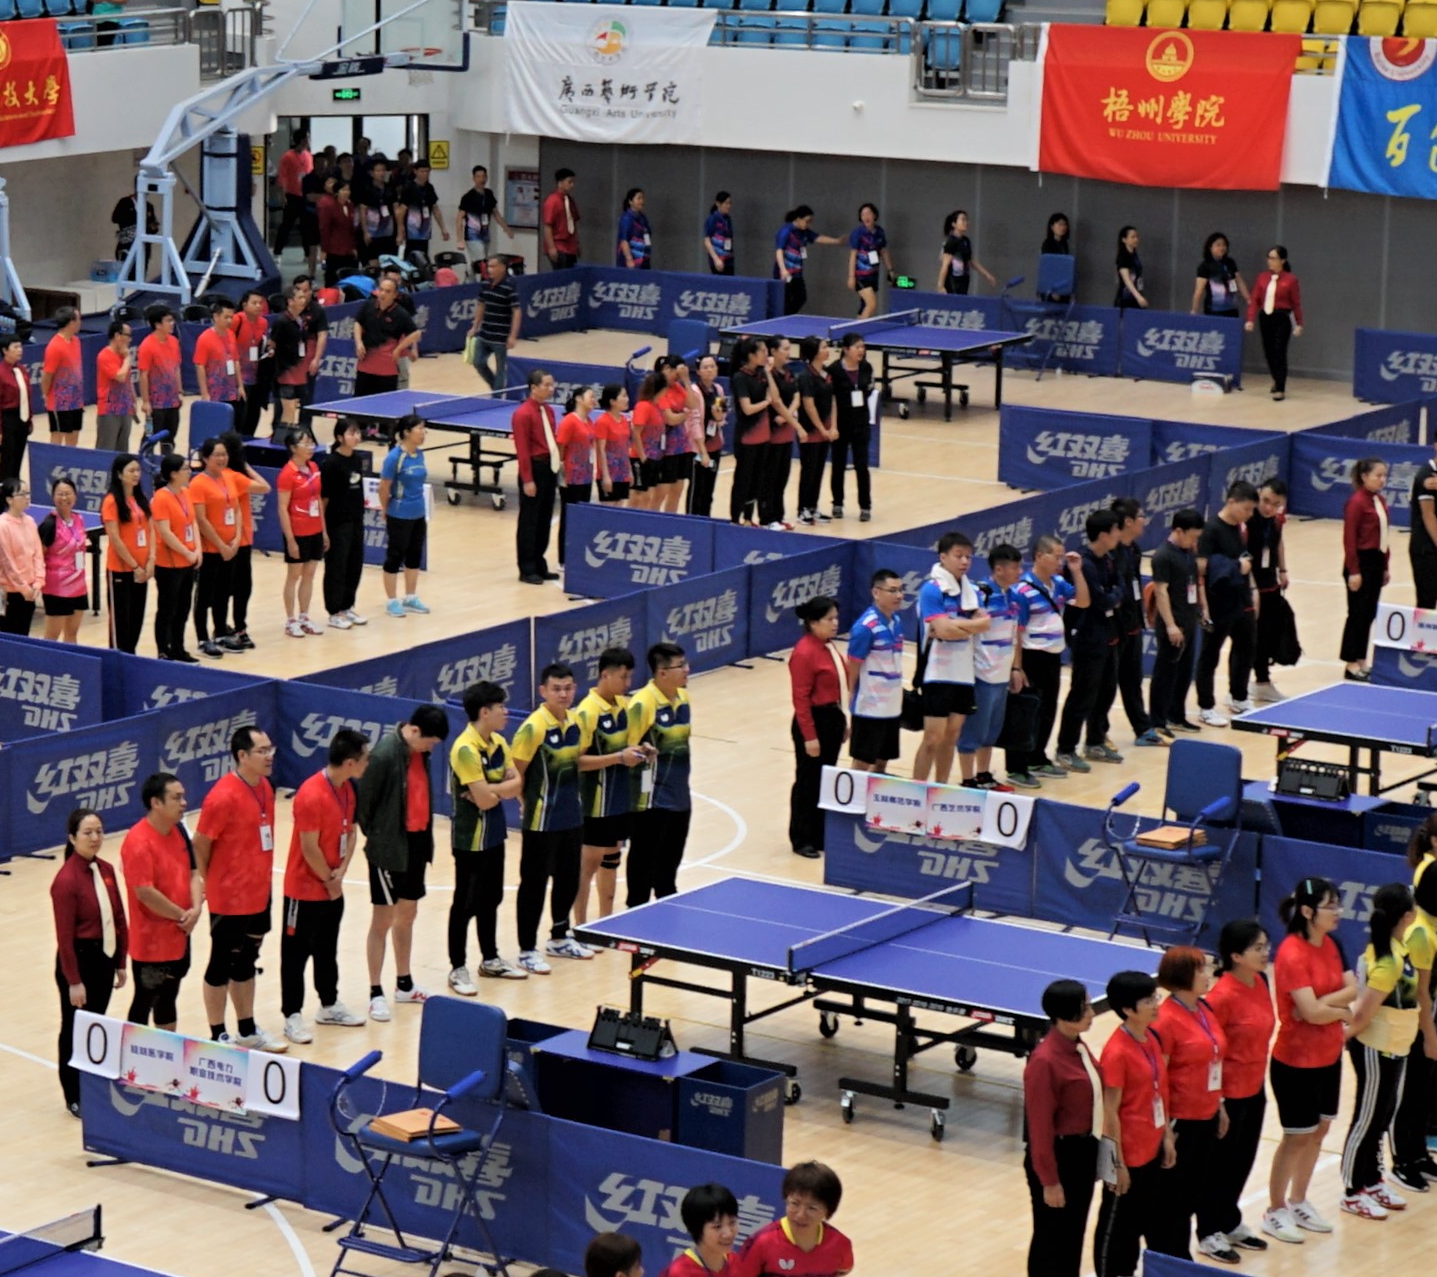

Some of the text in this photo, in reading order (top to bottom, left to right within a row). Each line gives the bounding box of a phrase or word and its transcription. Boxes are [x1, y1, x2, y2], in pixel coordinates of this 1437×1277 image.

[1157, 131, 1218, 146] UNIVERSITY
[1027, 429, 1130, 467] 红双喜
[27, 743, 140, 813] 红双喜
[833, 772, 855, 806] 0
[996, 802, 1019, 838] 0
[86, 1021, 108, 1065] 0
[263, 1060, 286, 1105] 0
